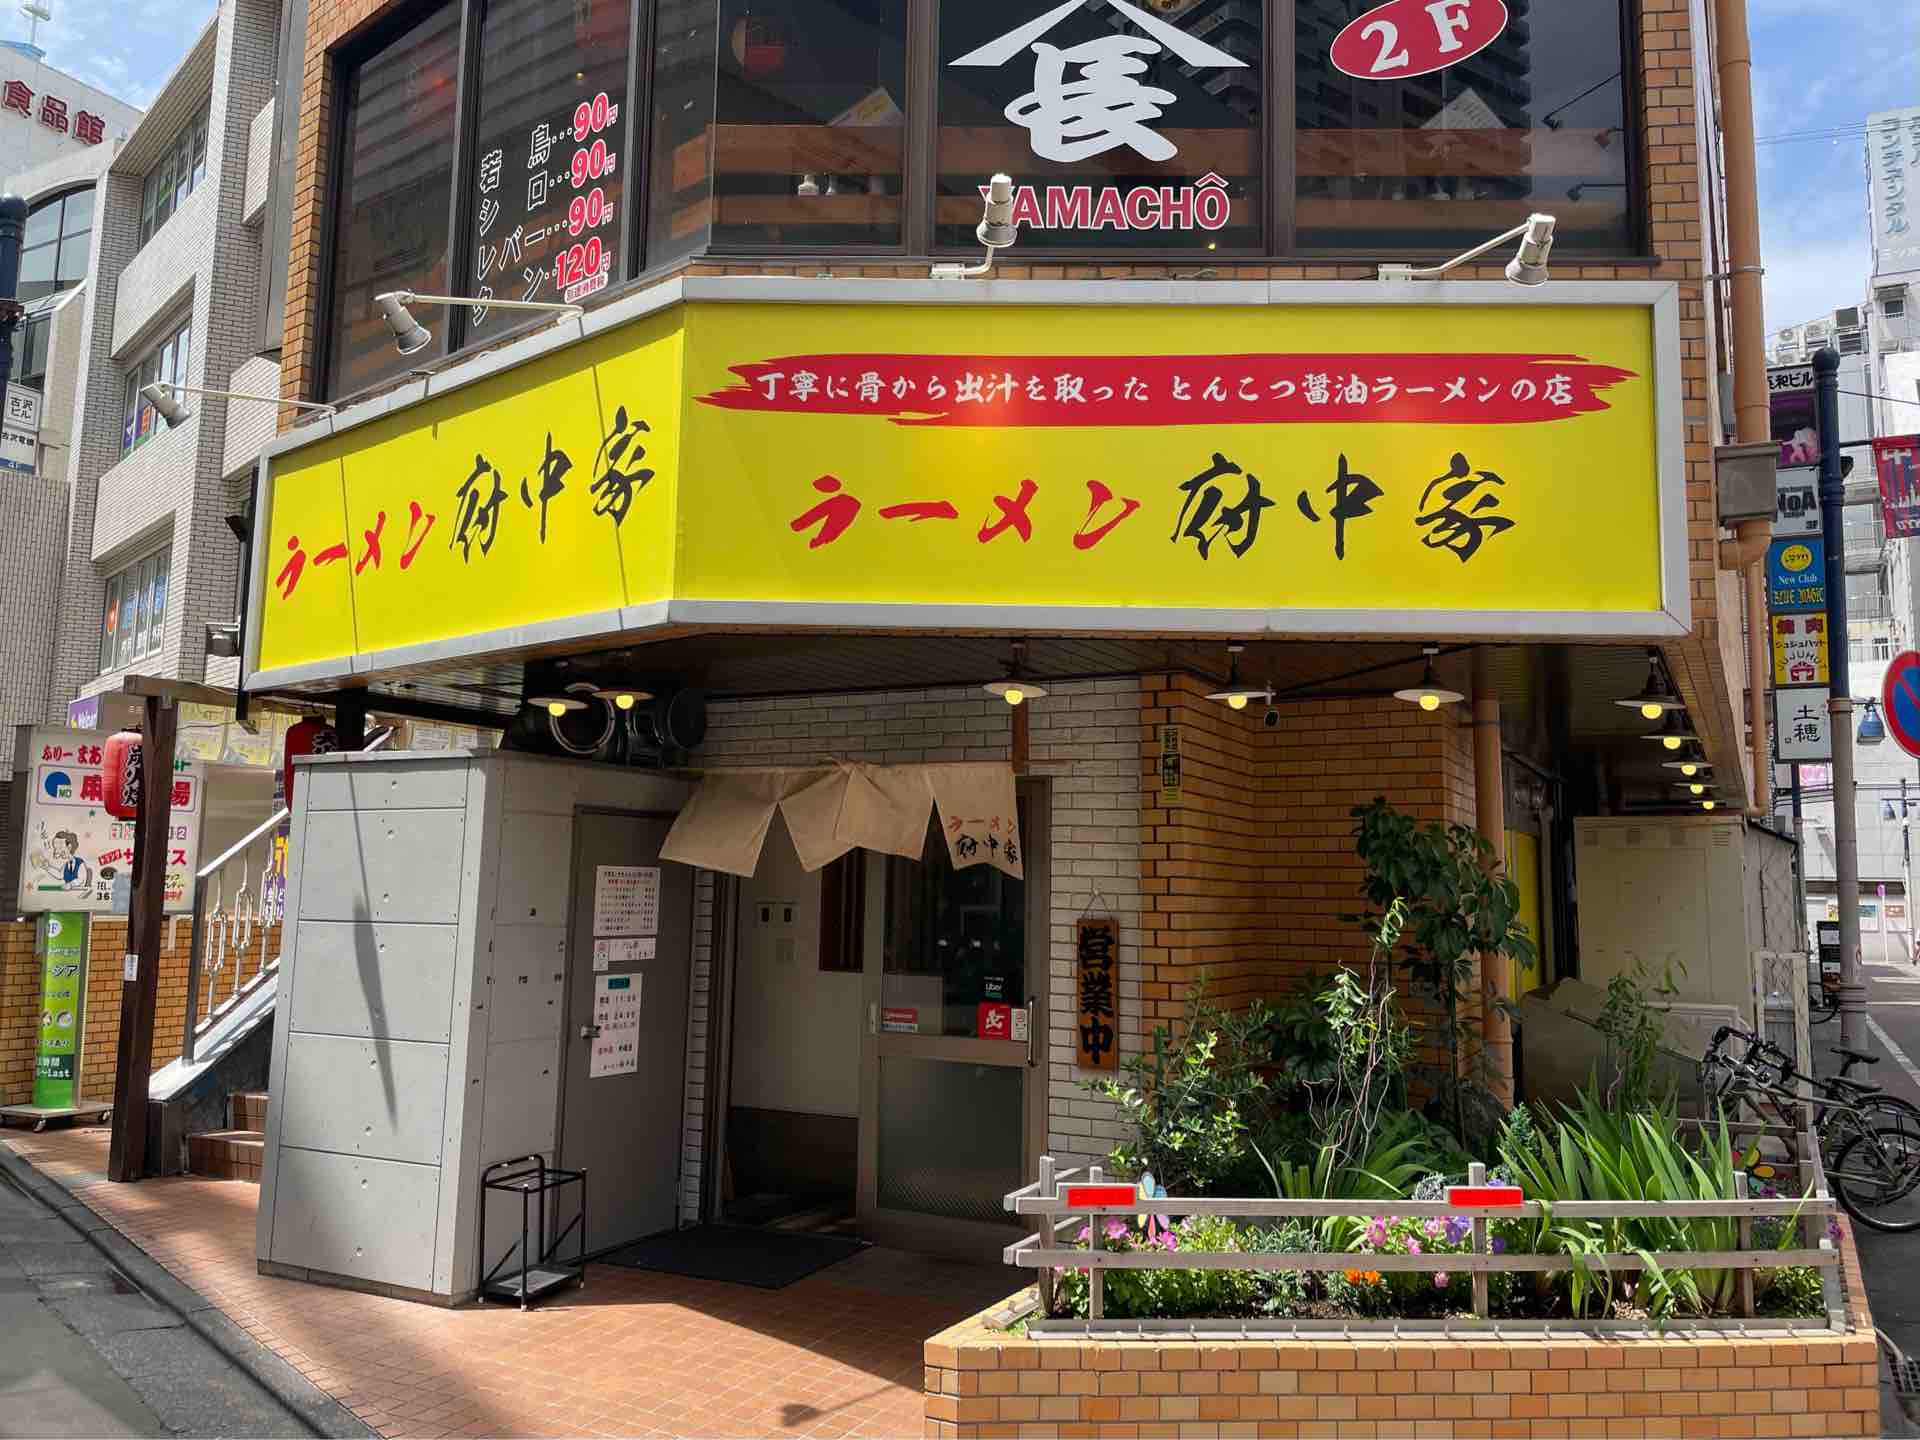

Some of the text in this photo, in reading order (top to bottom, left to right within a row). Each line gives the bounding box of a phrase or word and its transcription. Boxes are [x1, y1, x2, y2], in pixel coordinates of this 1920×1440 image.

[3, 79, 106, 145] 食品館
[574, 92, 618, 142] 90円
[571, 138, 616, 189] 90円
[568, 187, 614, 237] 90円
[555, 236, 611, 290] 120円
[756, 369, 1574, 405] 丁寧に骨から出汁を取った とんこつ醤油ラーメンの店
[276, 405, 655, 600] ラーメン 府中家
[789, 452, 1516, 563] ラーメン 府中家
[957, 832, 1019, 865] 府中家
